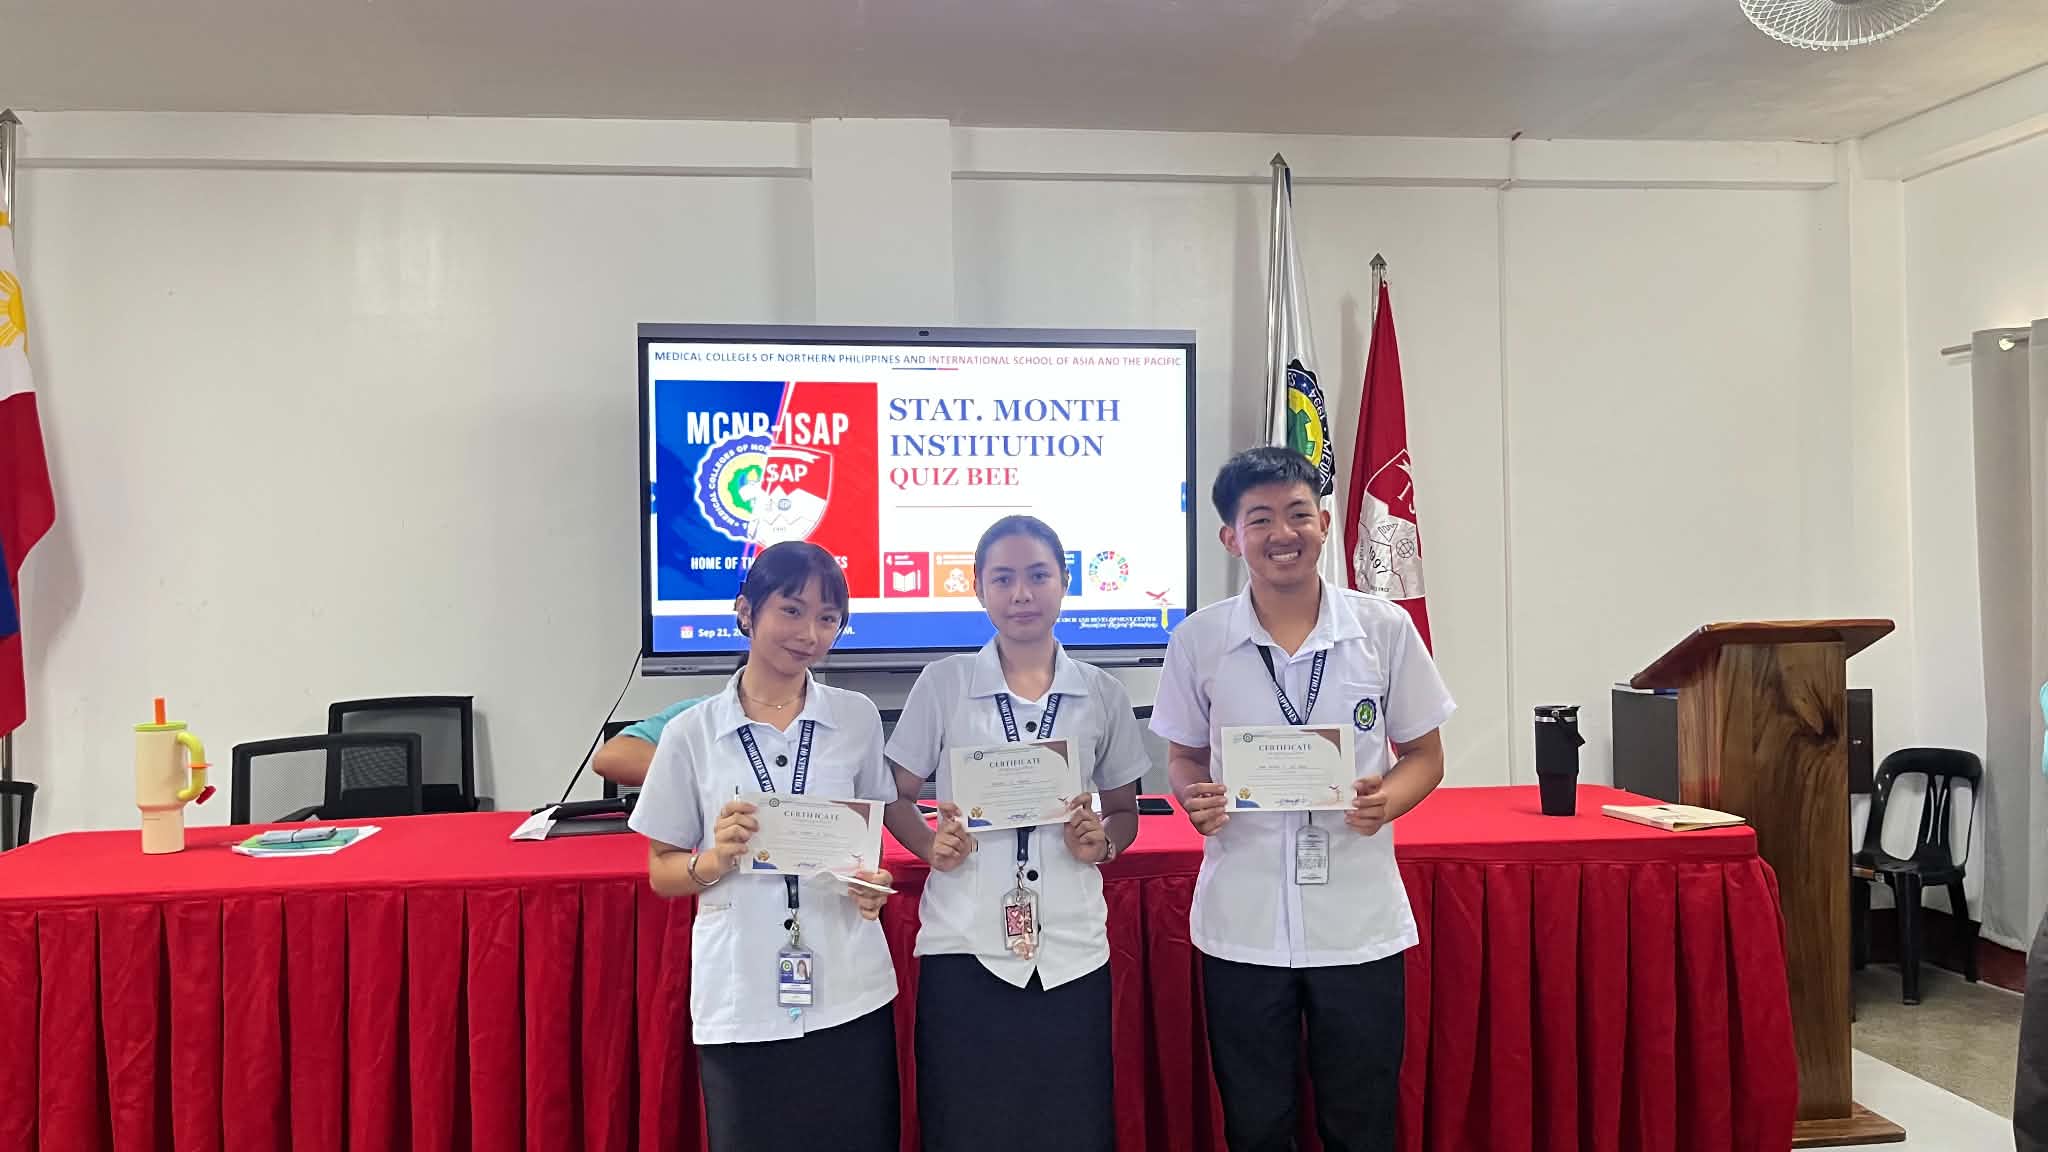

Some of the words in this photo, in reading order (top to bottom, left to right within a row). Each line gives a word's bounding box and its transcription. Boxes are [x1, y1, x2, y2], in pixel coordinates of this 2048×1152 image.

[654, 351, 702, 361] MEDICAL
[705, 352, 758, 362] COLLEGES
[760, 353, 774, 362] OF
[777, 353, 836, 363] NORTHERN
[839, 354, 900, 364] PHILIPPINES
[903, 355, 926, 364] AND
[928, 355, 1011, 365] INTERNATIONAL
[1013, 356, 1053, 366] SCHOOL
[1056, 356, 1069, 366] OF
[1072, 356, 1095, 366] ASIA
[1098, 357, 1120, 366] AND
[1122, 357, 1142, 366] THE
[1143, 357, 1183, 366] PACIFIC
[889, 398, 983, 422] STAT.
[992, 399, 1121, 422] MONTH
[687, 411, 849, 445] MCNP-ISAP
[889, 434, 1105, 457] INSTITUTION
[889, 467, 960, 490] QUIZ
[967, 467, 1020, 486] BEE
[690, 556, 722, 570] HOME
[724, 556, 739, 570] OF
[698, 628, 715, 639] Sep
[1258, 743, 1313, 752] CERTIFICATE
[989, 757, 1041, 768] CERTIFICATE
[783, 810, 840, 822] CERTIFICATE
